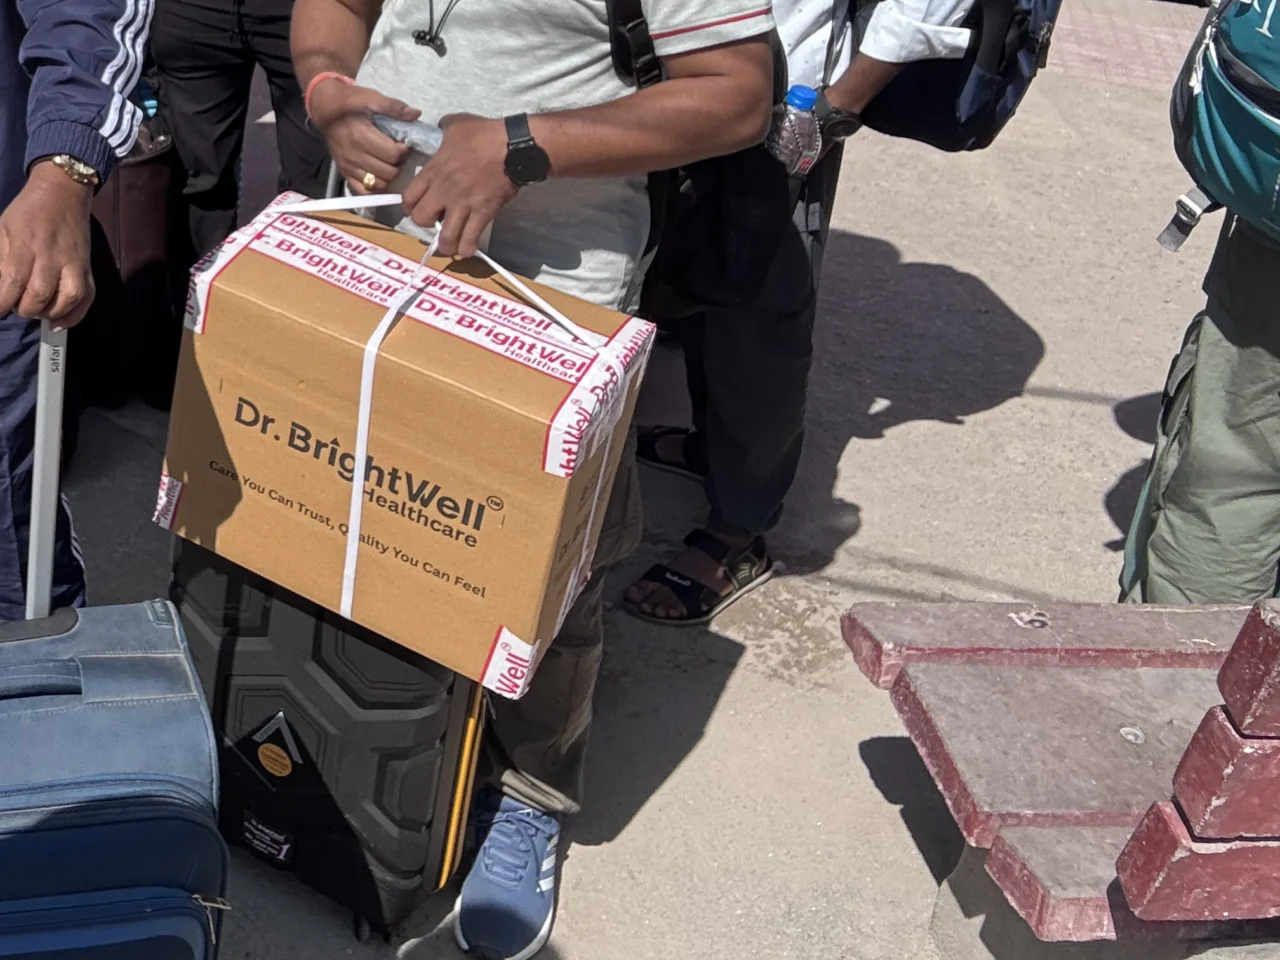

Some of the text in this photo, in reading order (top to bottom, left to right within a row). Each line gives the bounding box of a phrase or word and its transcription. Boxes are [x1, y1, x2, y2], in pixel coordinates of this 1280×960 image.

[279, 215, 369, 256] ghtWell
[421, 274, 553, 331] BrightWell
[290, 227, 358, 259] Healthcare
[317, 268, 389, 304] Healthcare
[275, 239, 400, 298] BrightWell
[414, 297, 451, 321] Dr.
[455, 314, 587, 373] BrightWel
[50, 344, 61, 373] safari
[235, 396, 280, 441] Dr.
[287, 421, 486, 532] BrightWell
[209, 460, 486, 598] Care You Can Trust, Qality You Can Feel
[362, 483, 478, 548] Healthcare
